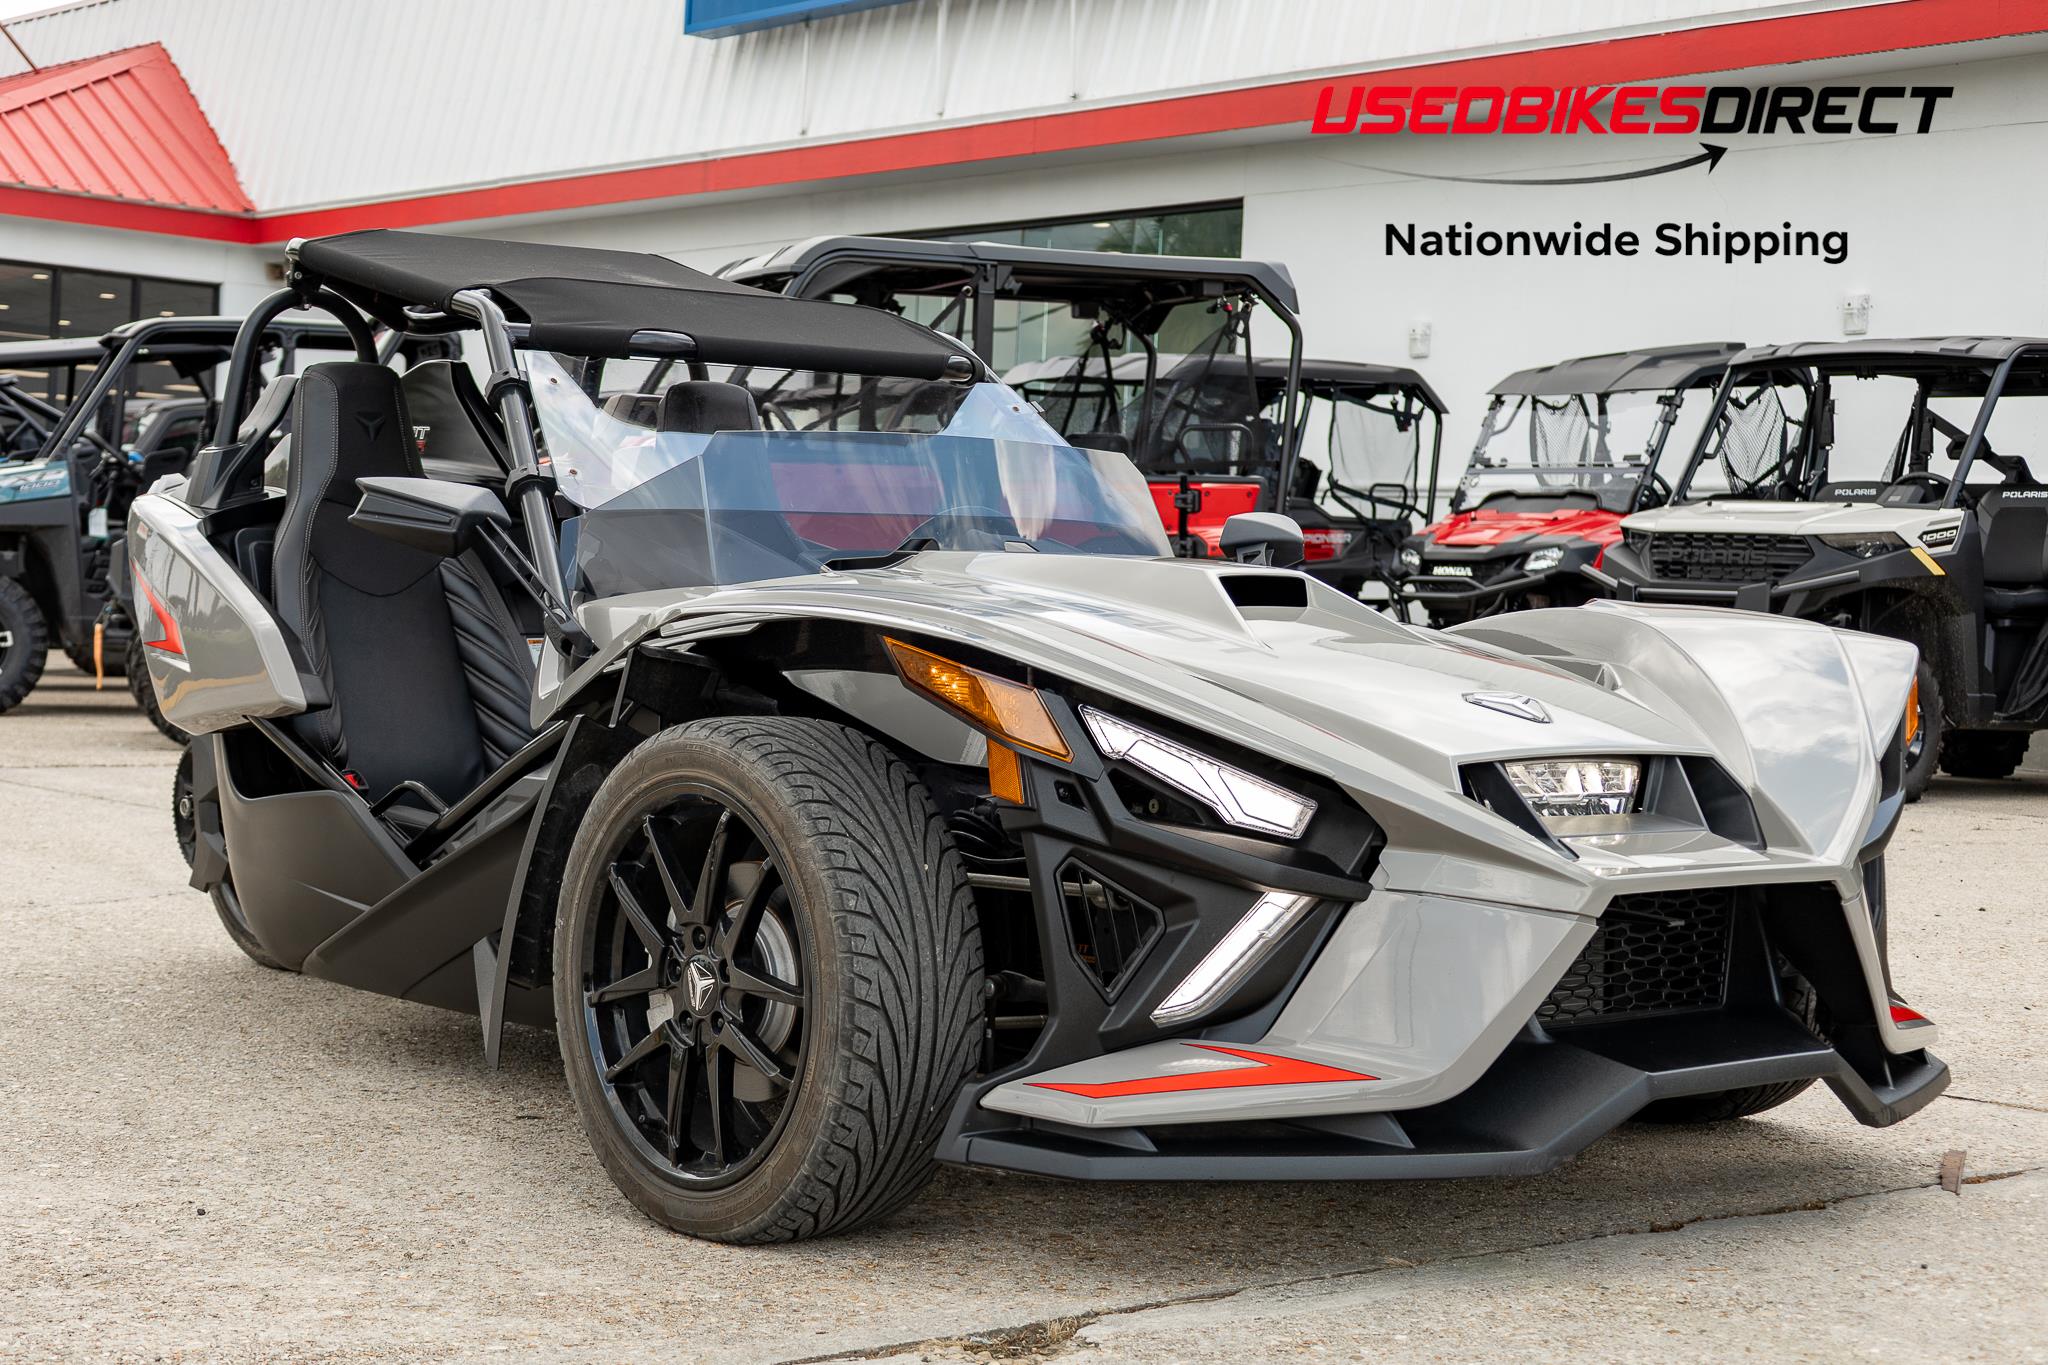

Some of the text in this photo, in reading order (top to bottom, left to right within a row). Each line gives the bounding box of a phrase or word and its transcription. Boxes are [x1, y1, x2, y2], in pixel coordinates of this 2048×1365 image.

[1835, 488, 1877, 496] POLARIS
[1923, 529, 1957, 541] 1000
[1667, 548, 1768, 565] POLARIS
[1432, 565, 1473, 577] HONDA
